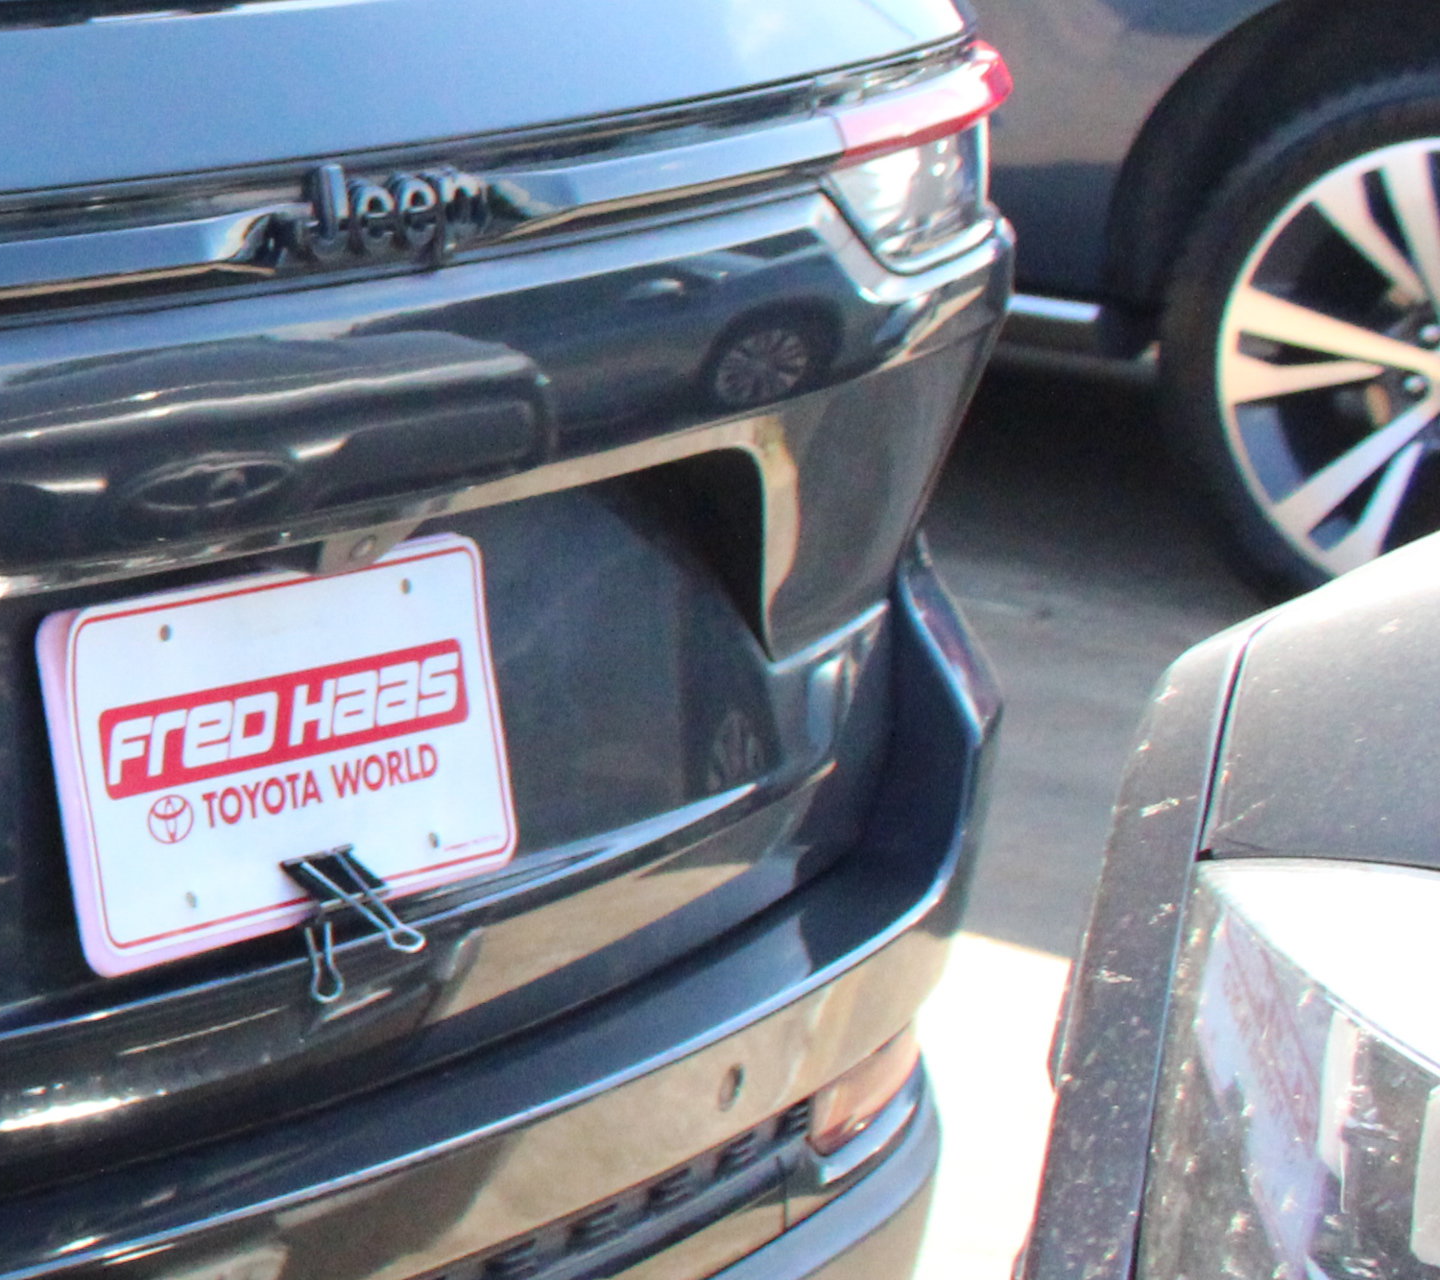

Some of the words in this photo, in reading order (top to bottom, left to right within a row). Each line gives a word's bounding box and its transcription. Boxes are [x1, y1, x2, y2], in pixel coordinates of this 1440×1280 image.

[304, 164, 492, 268] Jeep
[201, 771, 323, 829] TOYOTA
[329, 742, 439, 800] WORLD
